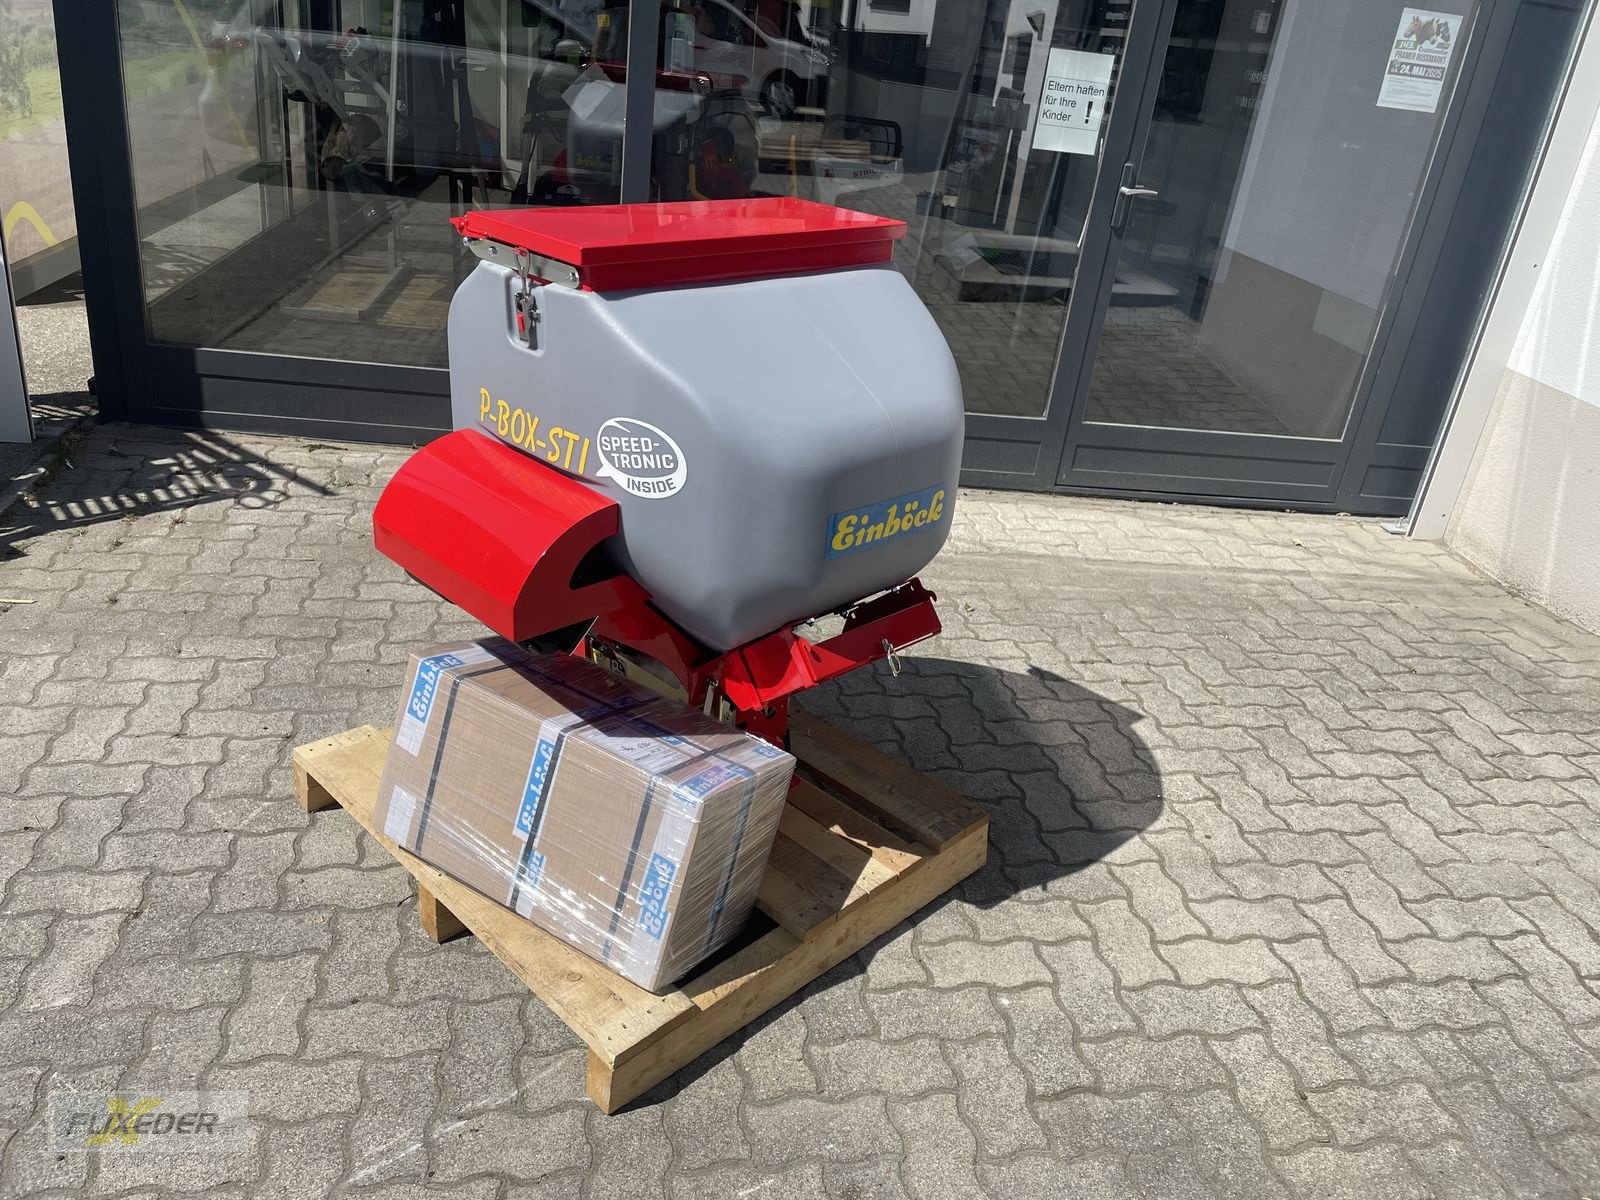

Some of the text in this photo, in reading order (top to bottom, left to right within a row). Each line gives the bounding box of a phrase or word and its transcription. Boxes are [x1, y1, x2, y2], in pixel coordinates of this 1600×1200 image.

[1400, 65, 1411, 75] 24.
[1411, 66, 1426, 77] MAI
[1425, 68, 1442, 79] 2025
[1047, 80, 1105, 97] Eltern haften
[1044, 95, 1077, 108] für Ihre
[1041, 109, 1072, 121] Kinder
[479, 387, 590, 475] P-BOX-STI
[601, 436, 660, 453] SPEED-
[611, 453, 675, 469] TRONIC
[627, 477, 676, 494] INSIDE
[831, 489, 945, 551] Einböck
